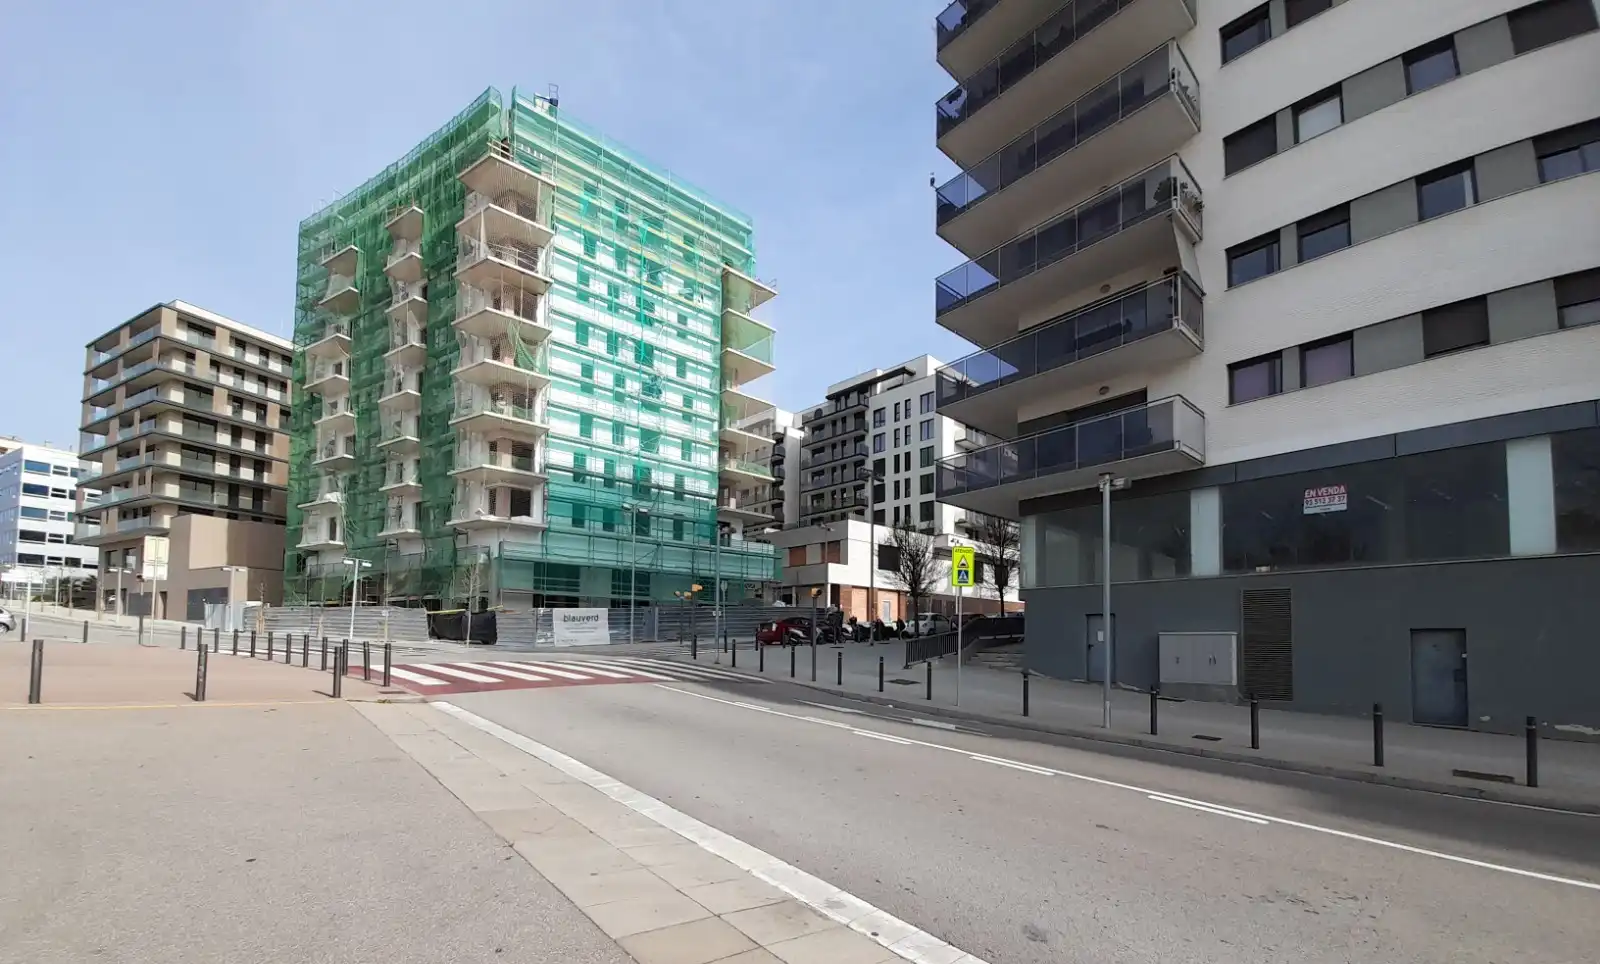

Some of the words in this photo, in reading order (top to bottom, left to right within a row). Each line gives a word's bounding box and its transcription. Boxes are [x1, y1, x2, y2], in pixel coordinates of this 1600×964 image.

[1304, 488, 1316, 498] EN
[1317, 485, 1346, 497] VENDA
[563, 613, 599, 622] blauverd
